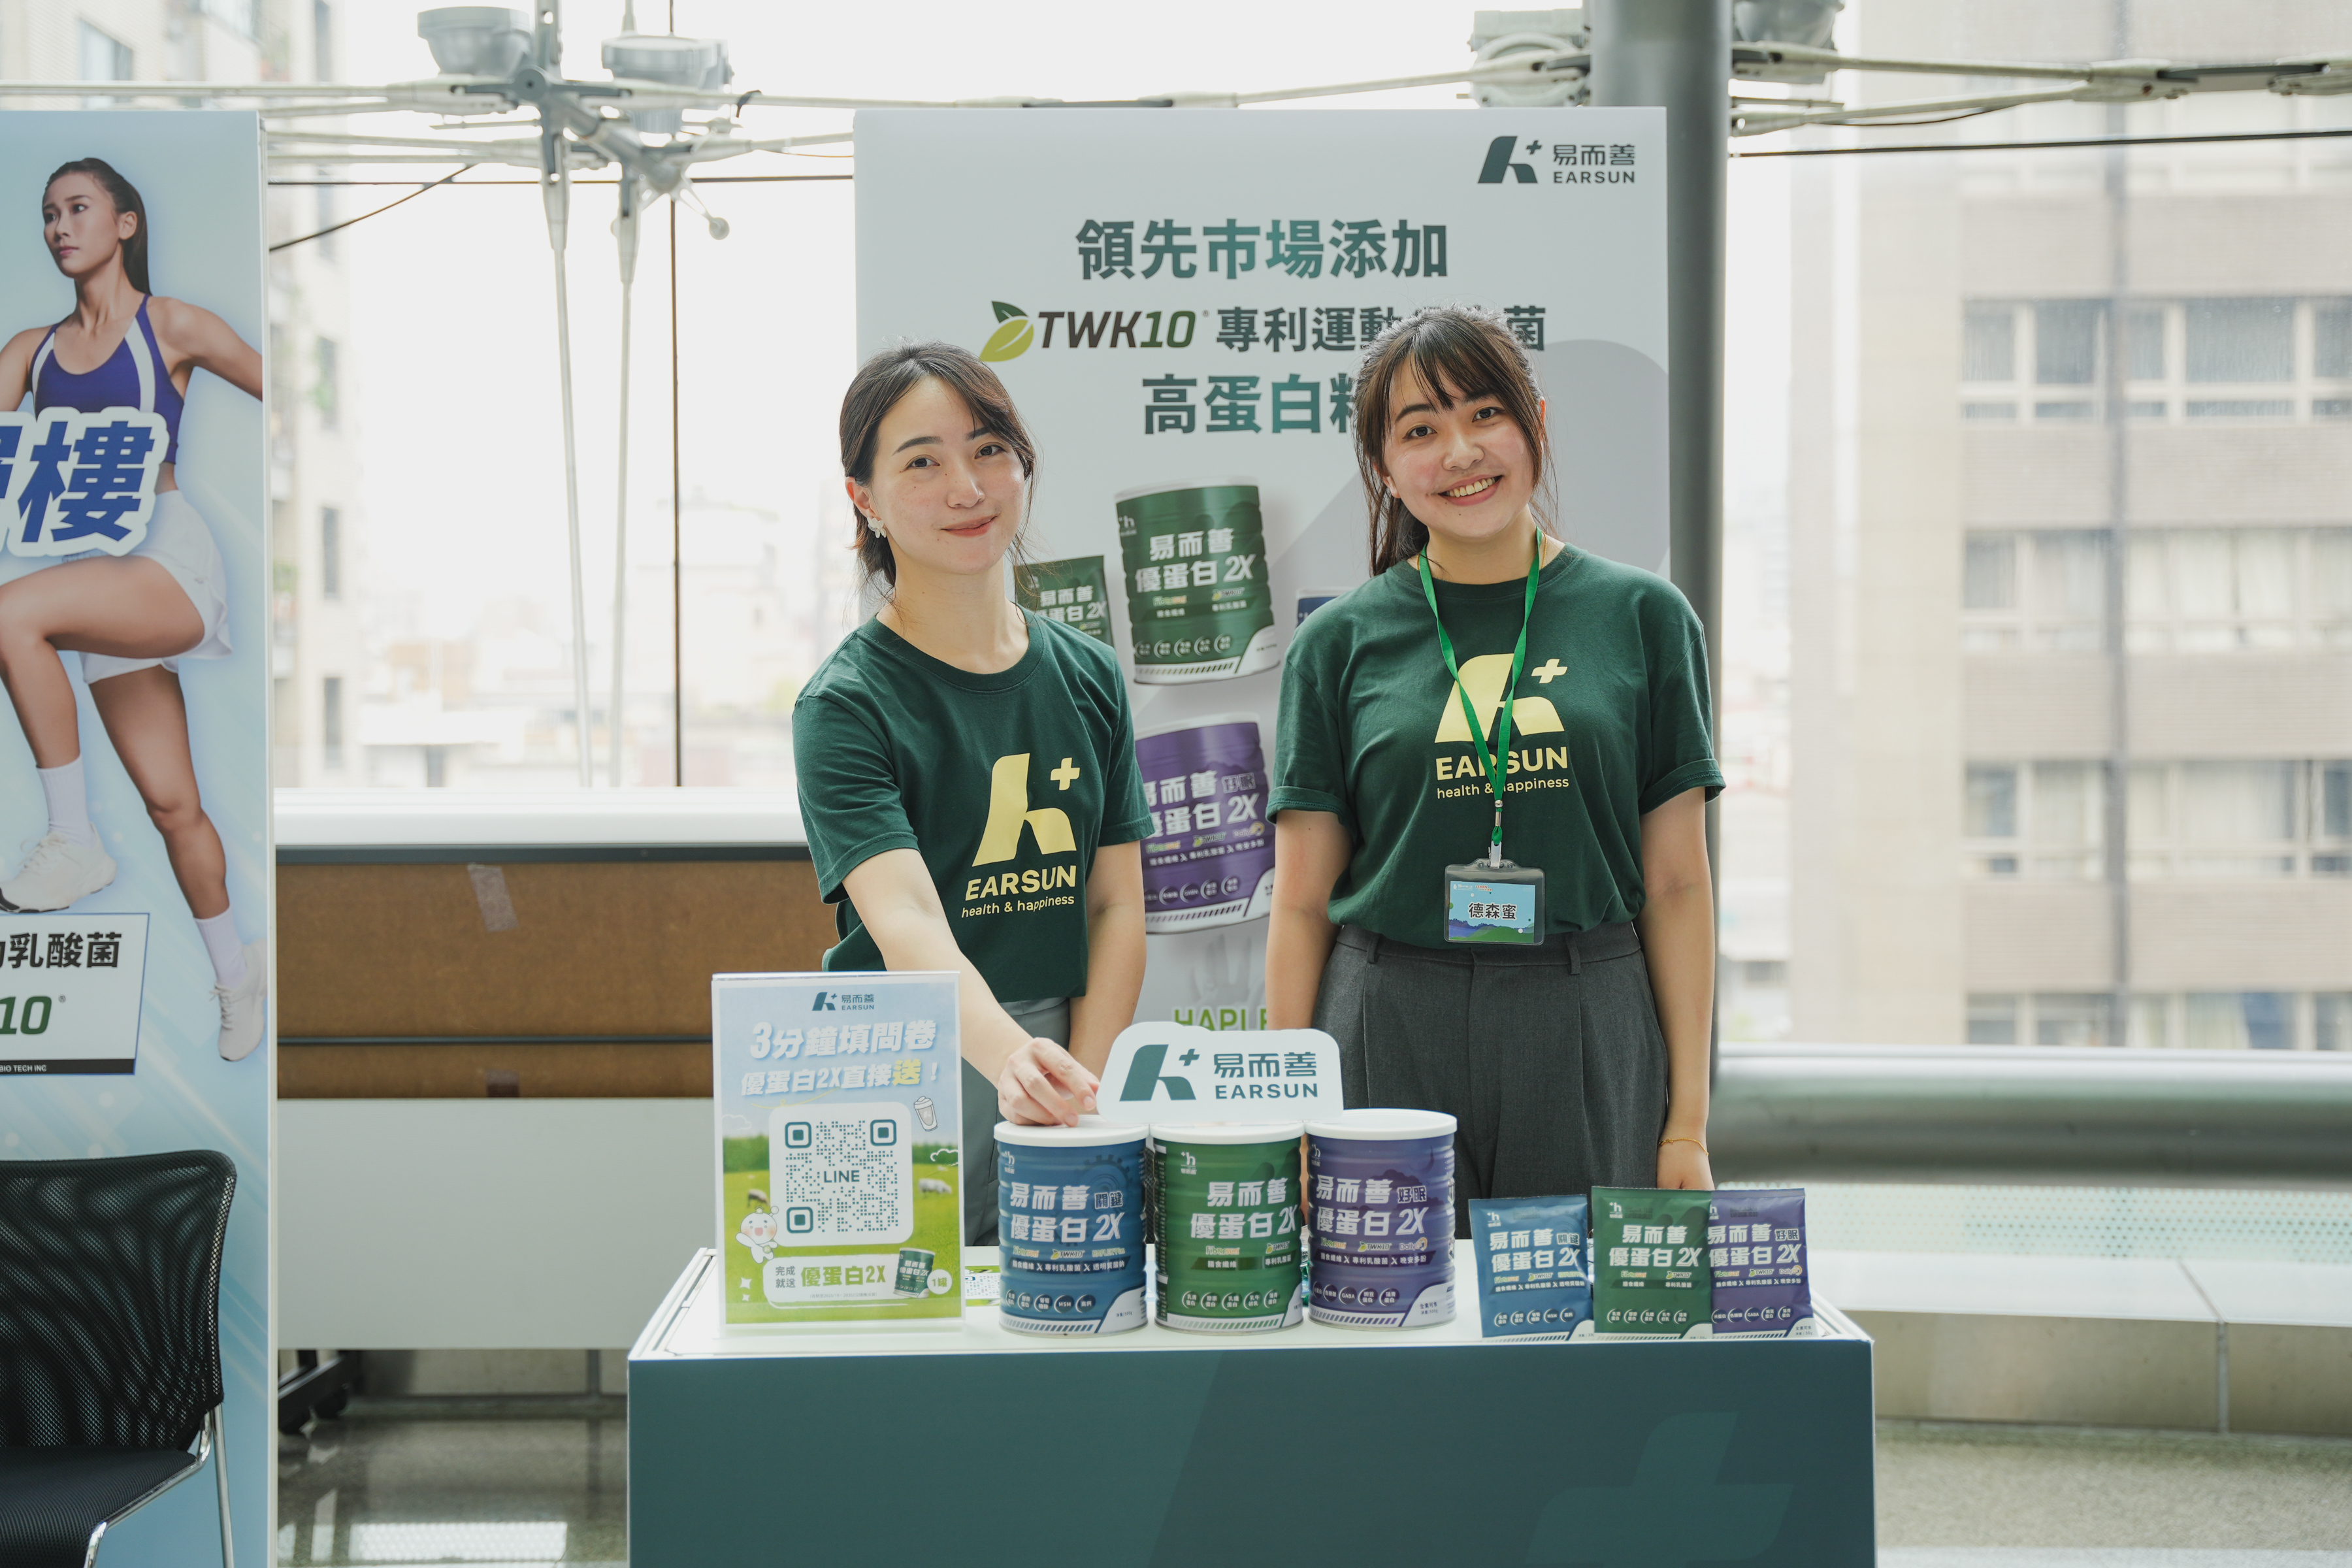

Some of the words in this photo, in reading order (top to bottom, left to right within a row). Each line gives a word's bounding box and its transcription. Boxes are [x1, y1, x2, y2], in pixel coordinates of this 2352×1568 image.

[1553, 144, 1635, 165] 易而善
[1553, 171, 1635, 184] EARSUN
[1076, 218, 1449, 280] 領先市場添加
[1217, 306, 1546, 352] 專利運動菌
[0, 421, 155, 543] 樓
[1150, 527, 1235, 562] 易而善
[1437, 784, 1480, 799] health
[1484, 783, 1494, 793] &
[1503, 777, 1569, 793] appiness
[965, 865, 1077, 901] EARSUN
[961, 902, 1000, 919] health
[1004, 902, 1013, 912] &
[1017, 896, 1075, 913] happiness
[1468, 902, 1516, 920] 德森蜜
[841, 994, 875, 1004] 易而善
[13, 1064, 33, 1073] TECH
[34, 1064, 47, 1073] INC
[1213, 1052, 1317, 1078] 易而善
[1215, 1083, 1318, 1100] EARSUN
[823, 1170, 860, 1183] LINE
[1011, 1182, 1090, 1210] 易而善
[1207, 1177, 1288, 1207] 易而善
[1316, 1174, 1394, 1204] 易而善
[1397, 1185, 1427, 1203] 好眠
[1490, 1228, 1554, 1251] 易而善
[1622, 1224, 1688, 1244] 易而善
[1707, 1223, 1772, 1245] 易而善
[1774, 1228, 1799, 1241] 好眠
[776, 1266, 796, 1276] 完成
[800, 1266, 886, 1287] 優蛋白2X
[776, 1278, 796, 1288] 就送
